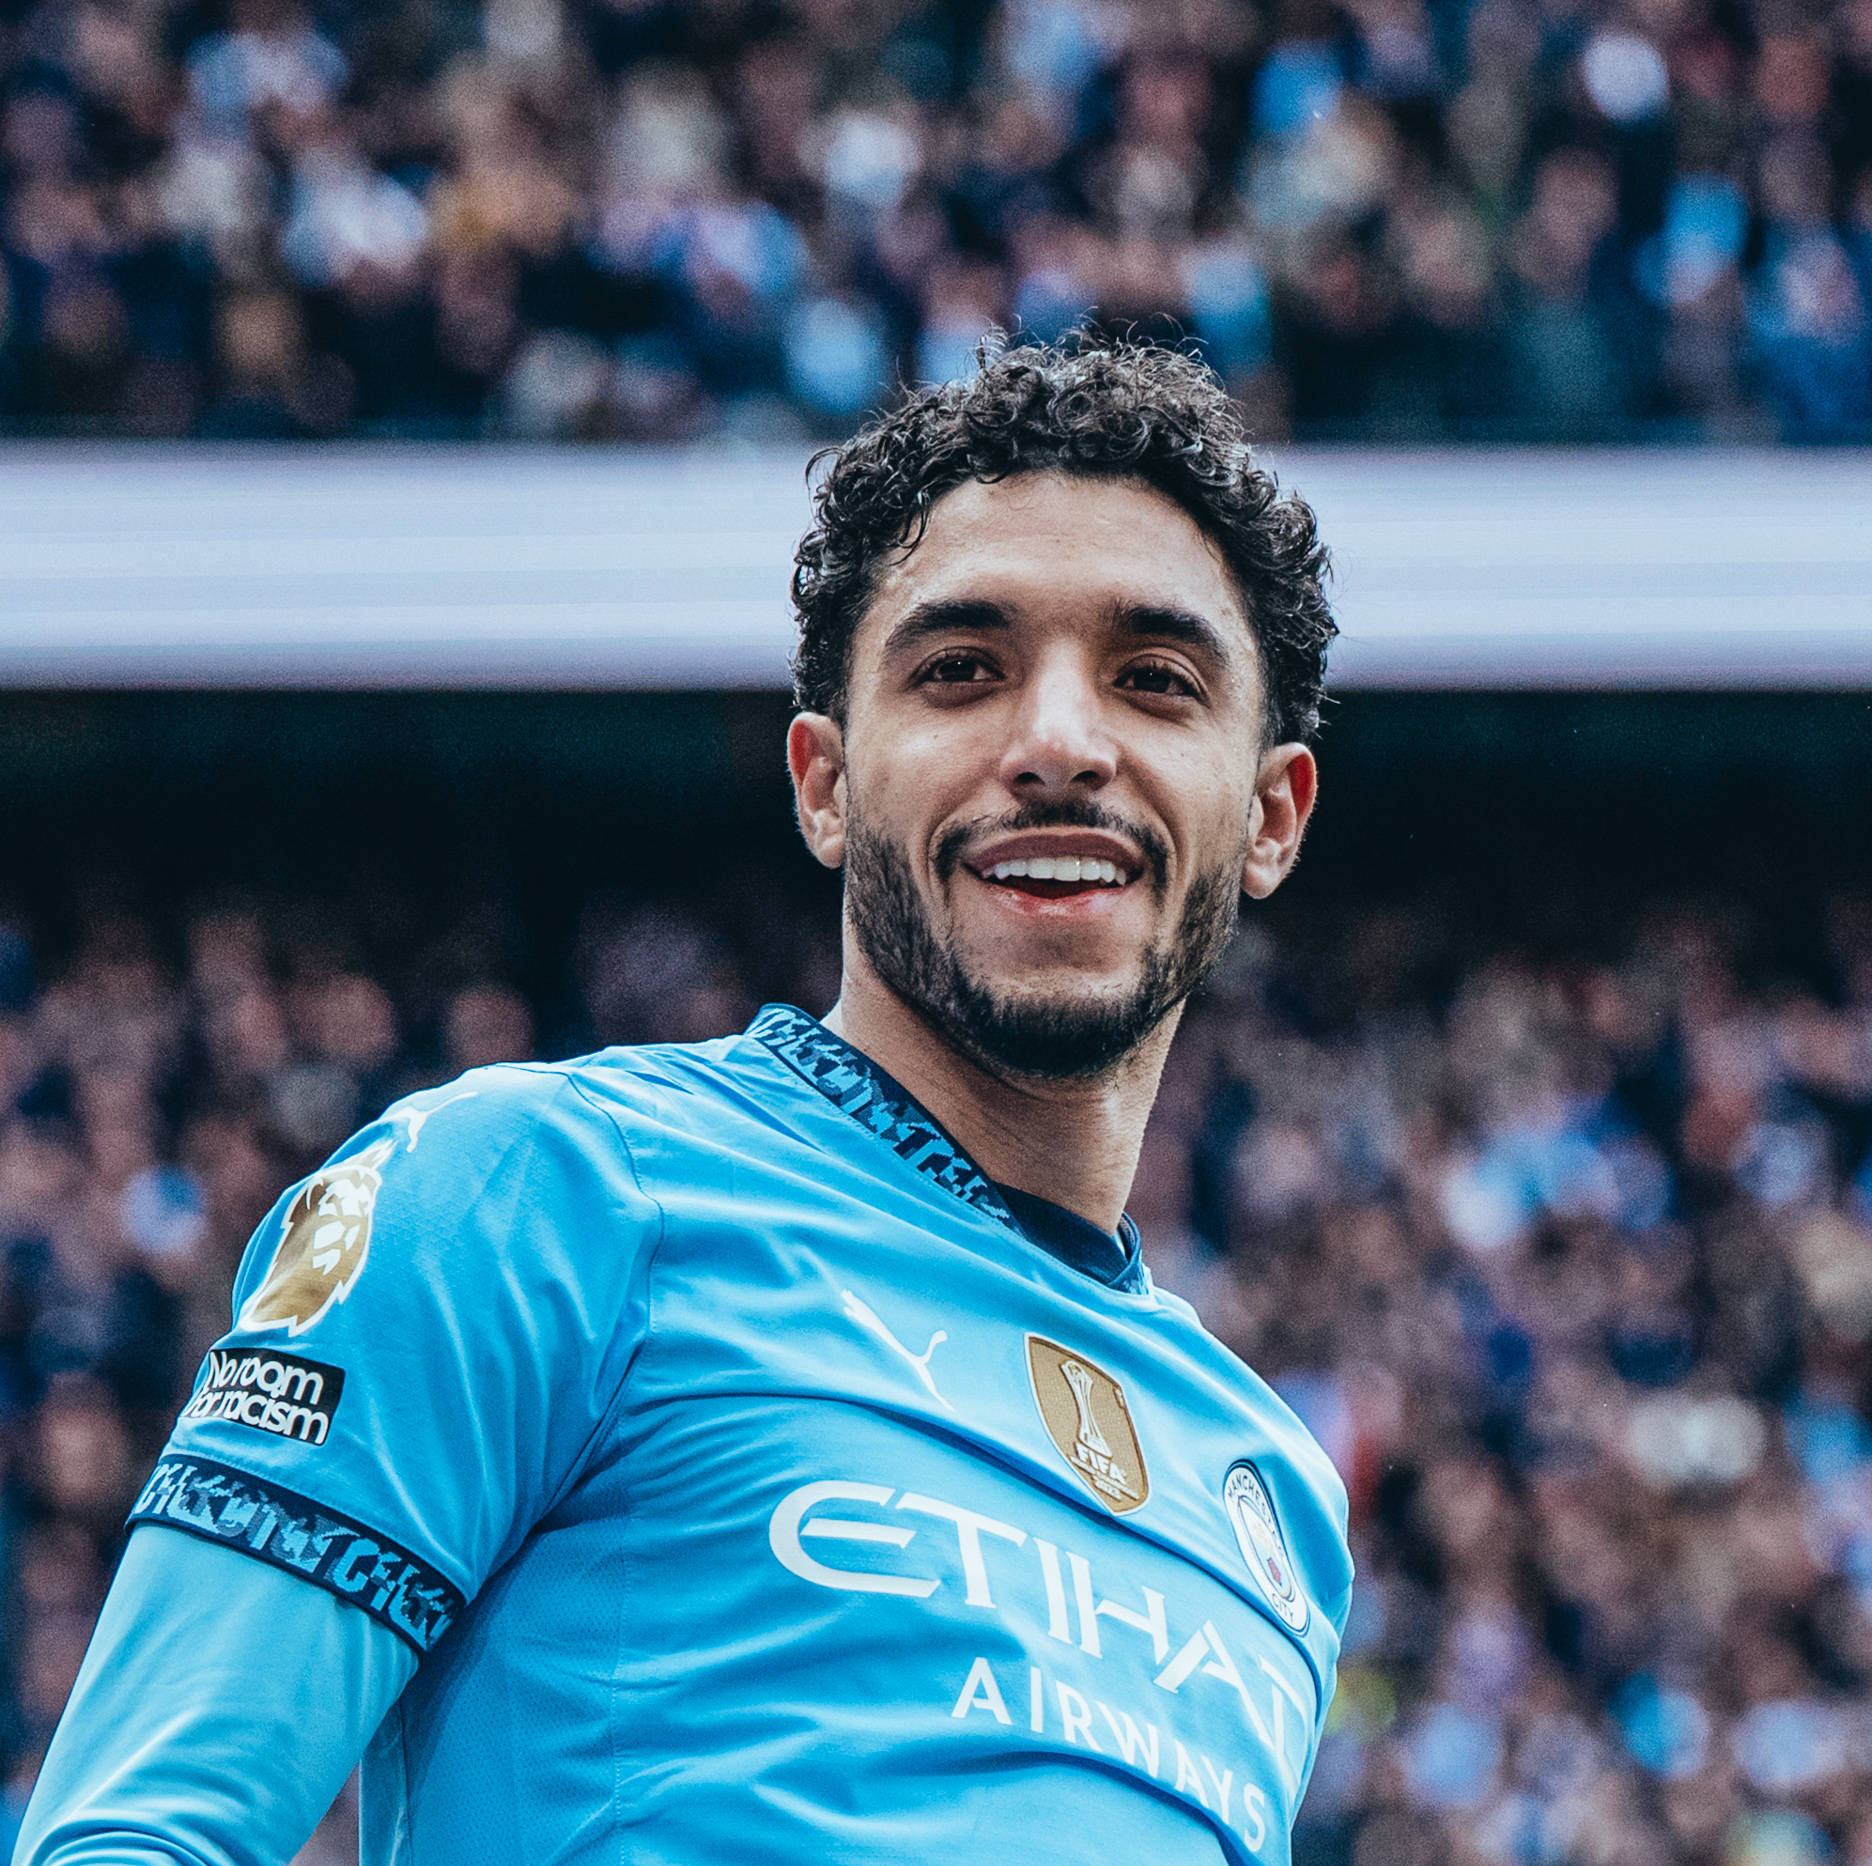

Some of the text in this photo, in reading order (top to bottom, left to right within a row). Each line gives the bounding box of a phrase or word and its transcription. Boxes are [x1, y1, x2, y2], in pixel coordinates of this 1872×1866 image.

[206, 1351, 324, 1405] No room
[212, 1390, 329, 1444] racism
[1075, 1442, 1128, 1485] FIFA
[951, 1657, 1266, 1852] AIRWAYS
